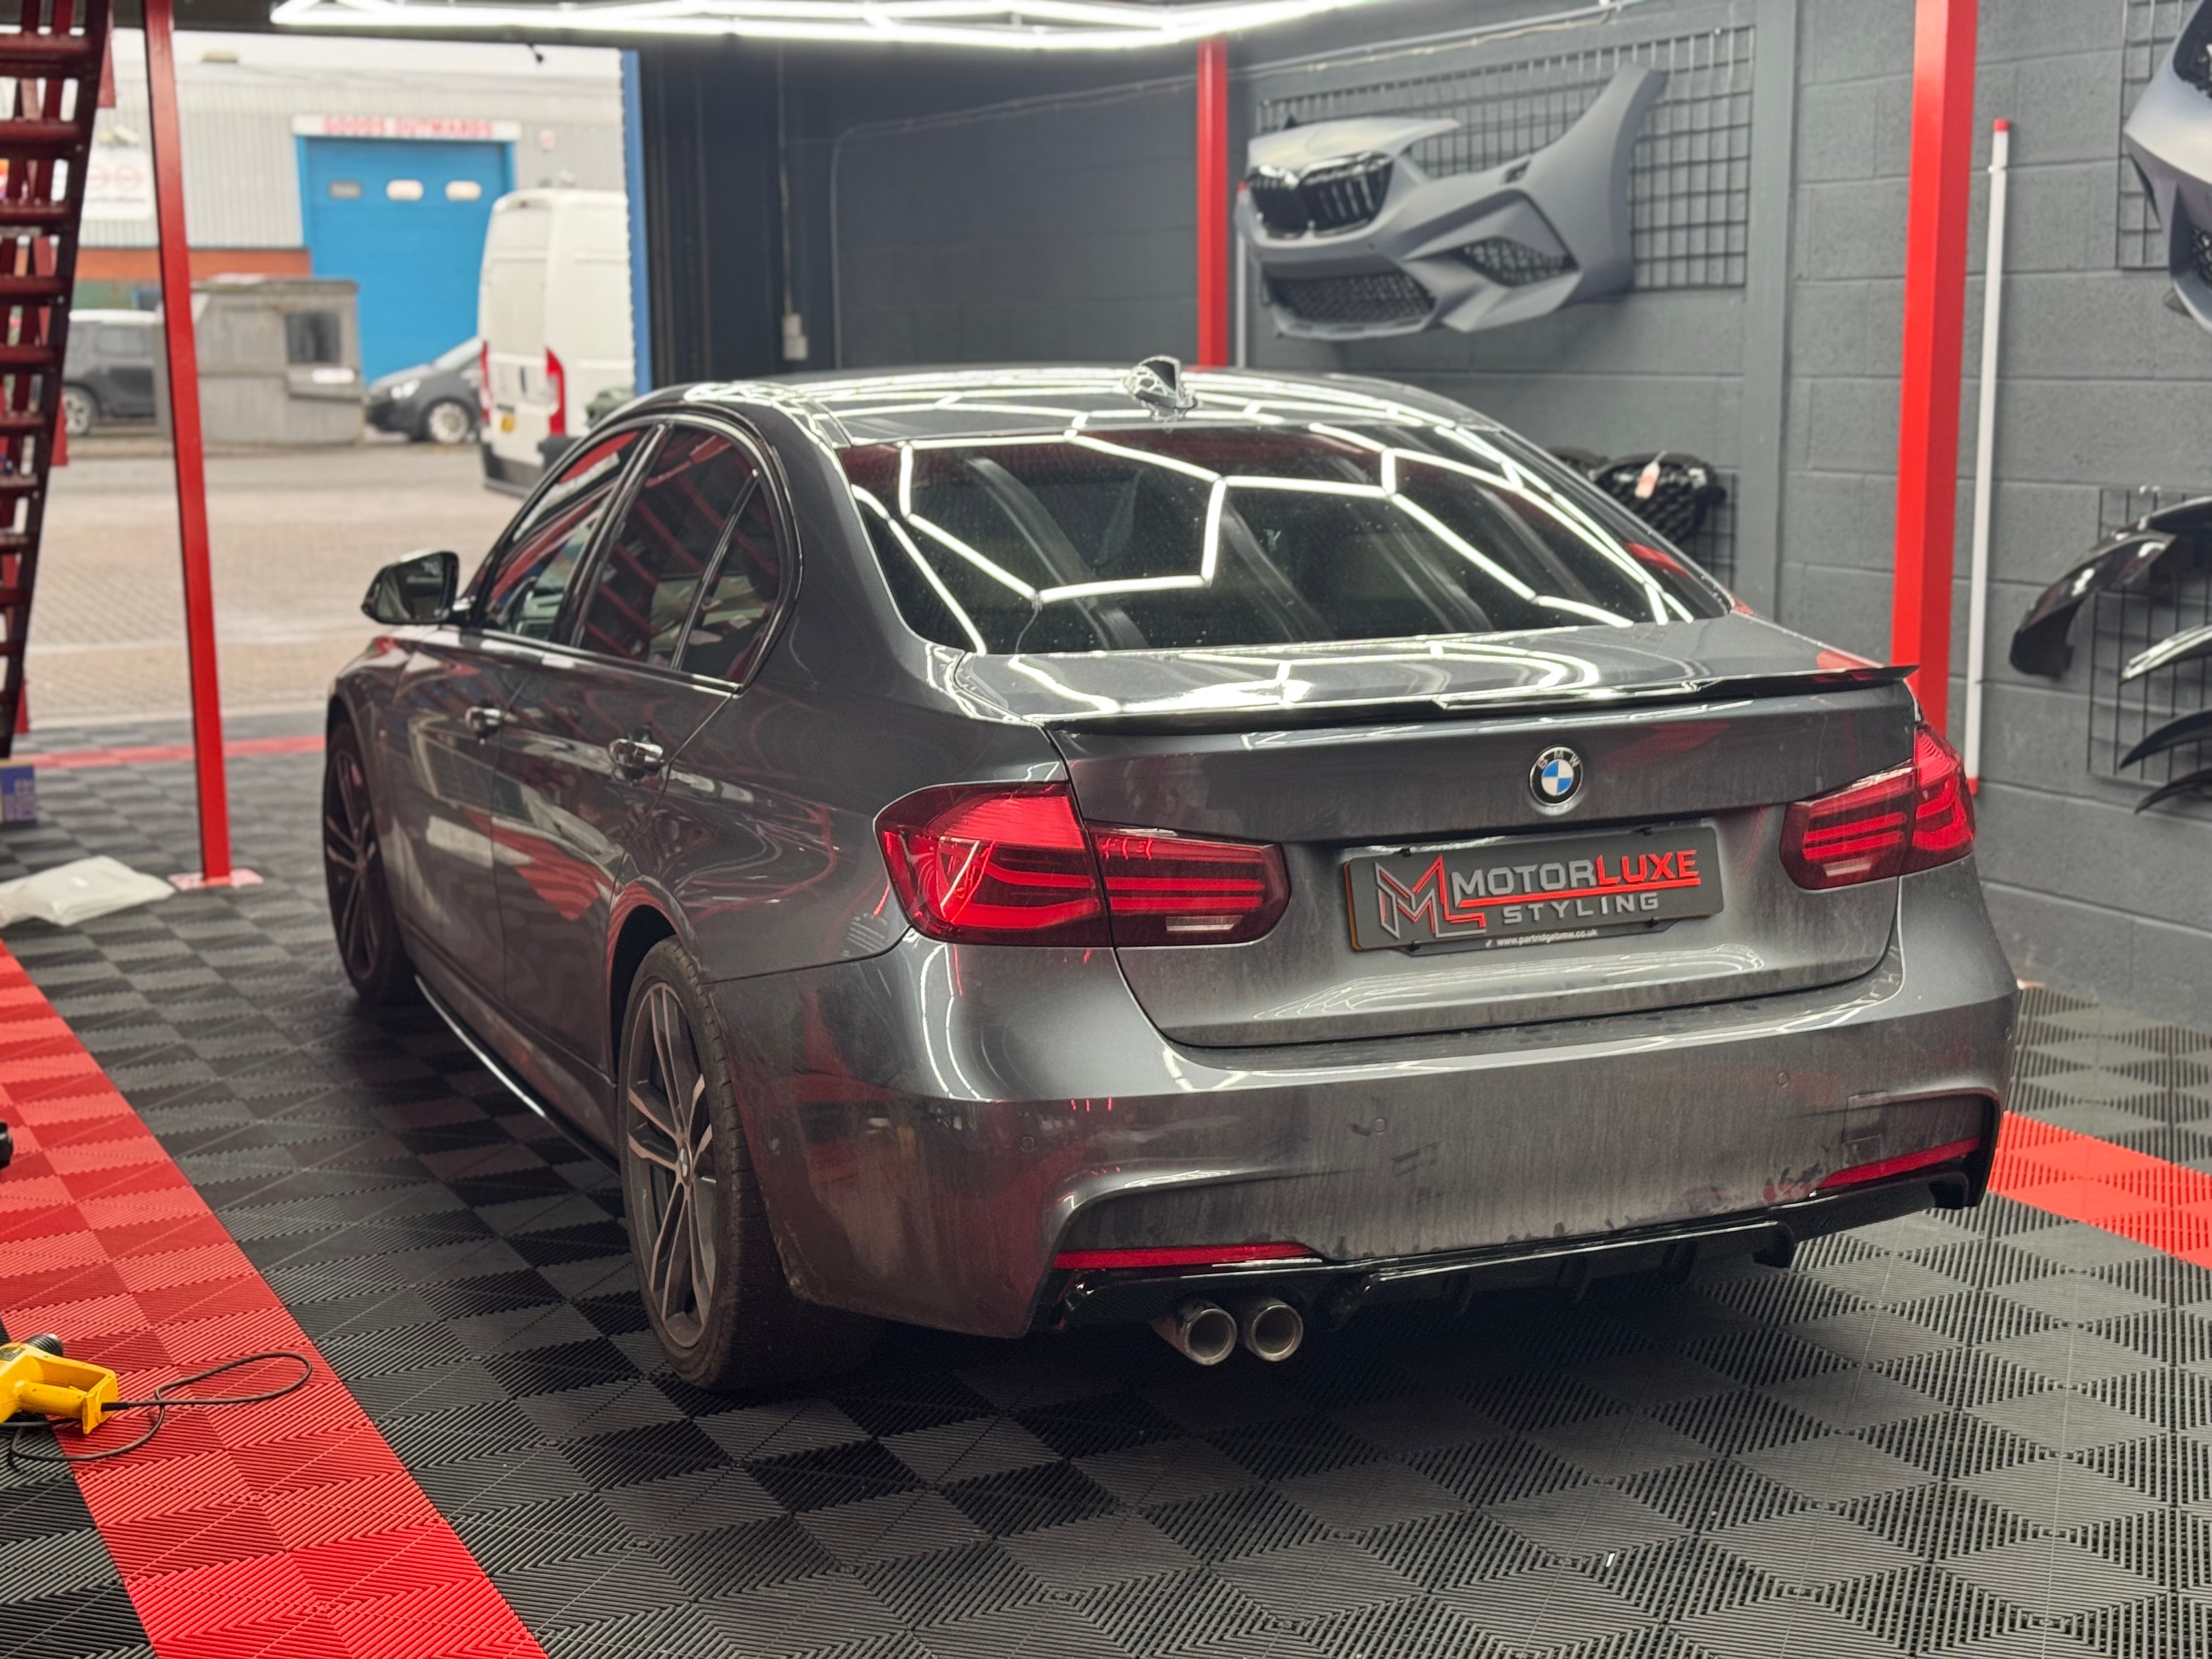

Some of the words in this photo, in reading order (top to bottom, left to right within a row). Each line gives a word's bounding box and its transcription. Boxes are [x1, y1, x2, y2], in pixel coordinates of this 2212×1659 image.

[1537, 749, 1580, 769] BMW
[1451, 849, 1700, 907] MOTORLUXE
[1503, 892, 1659, 924] STYLING
